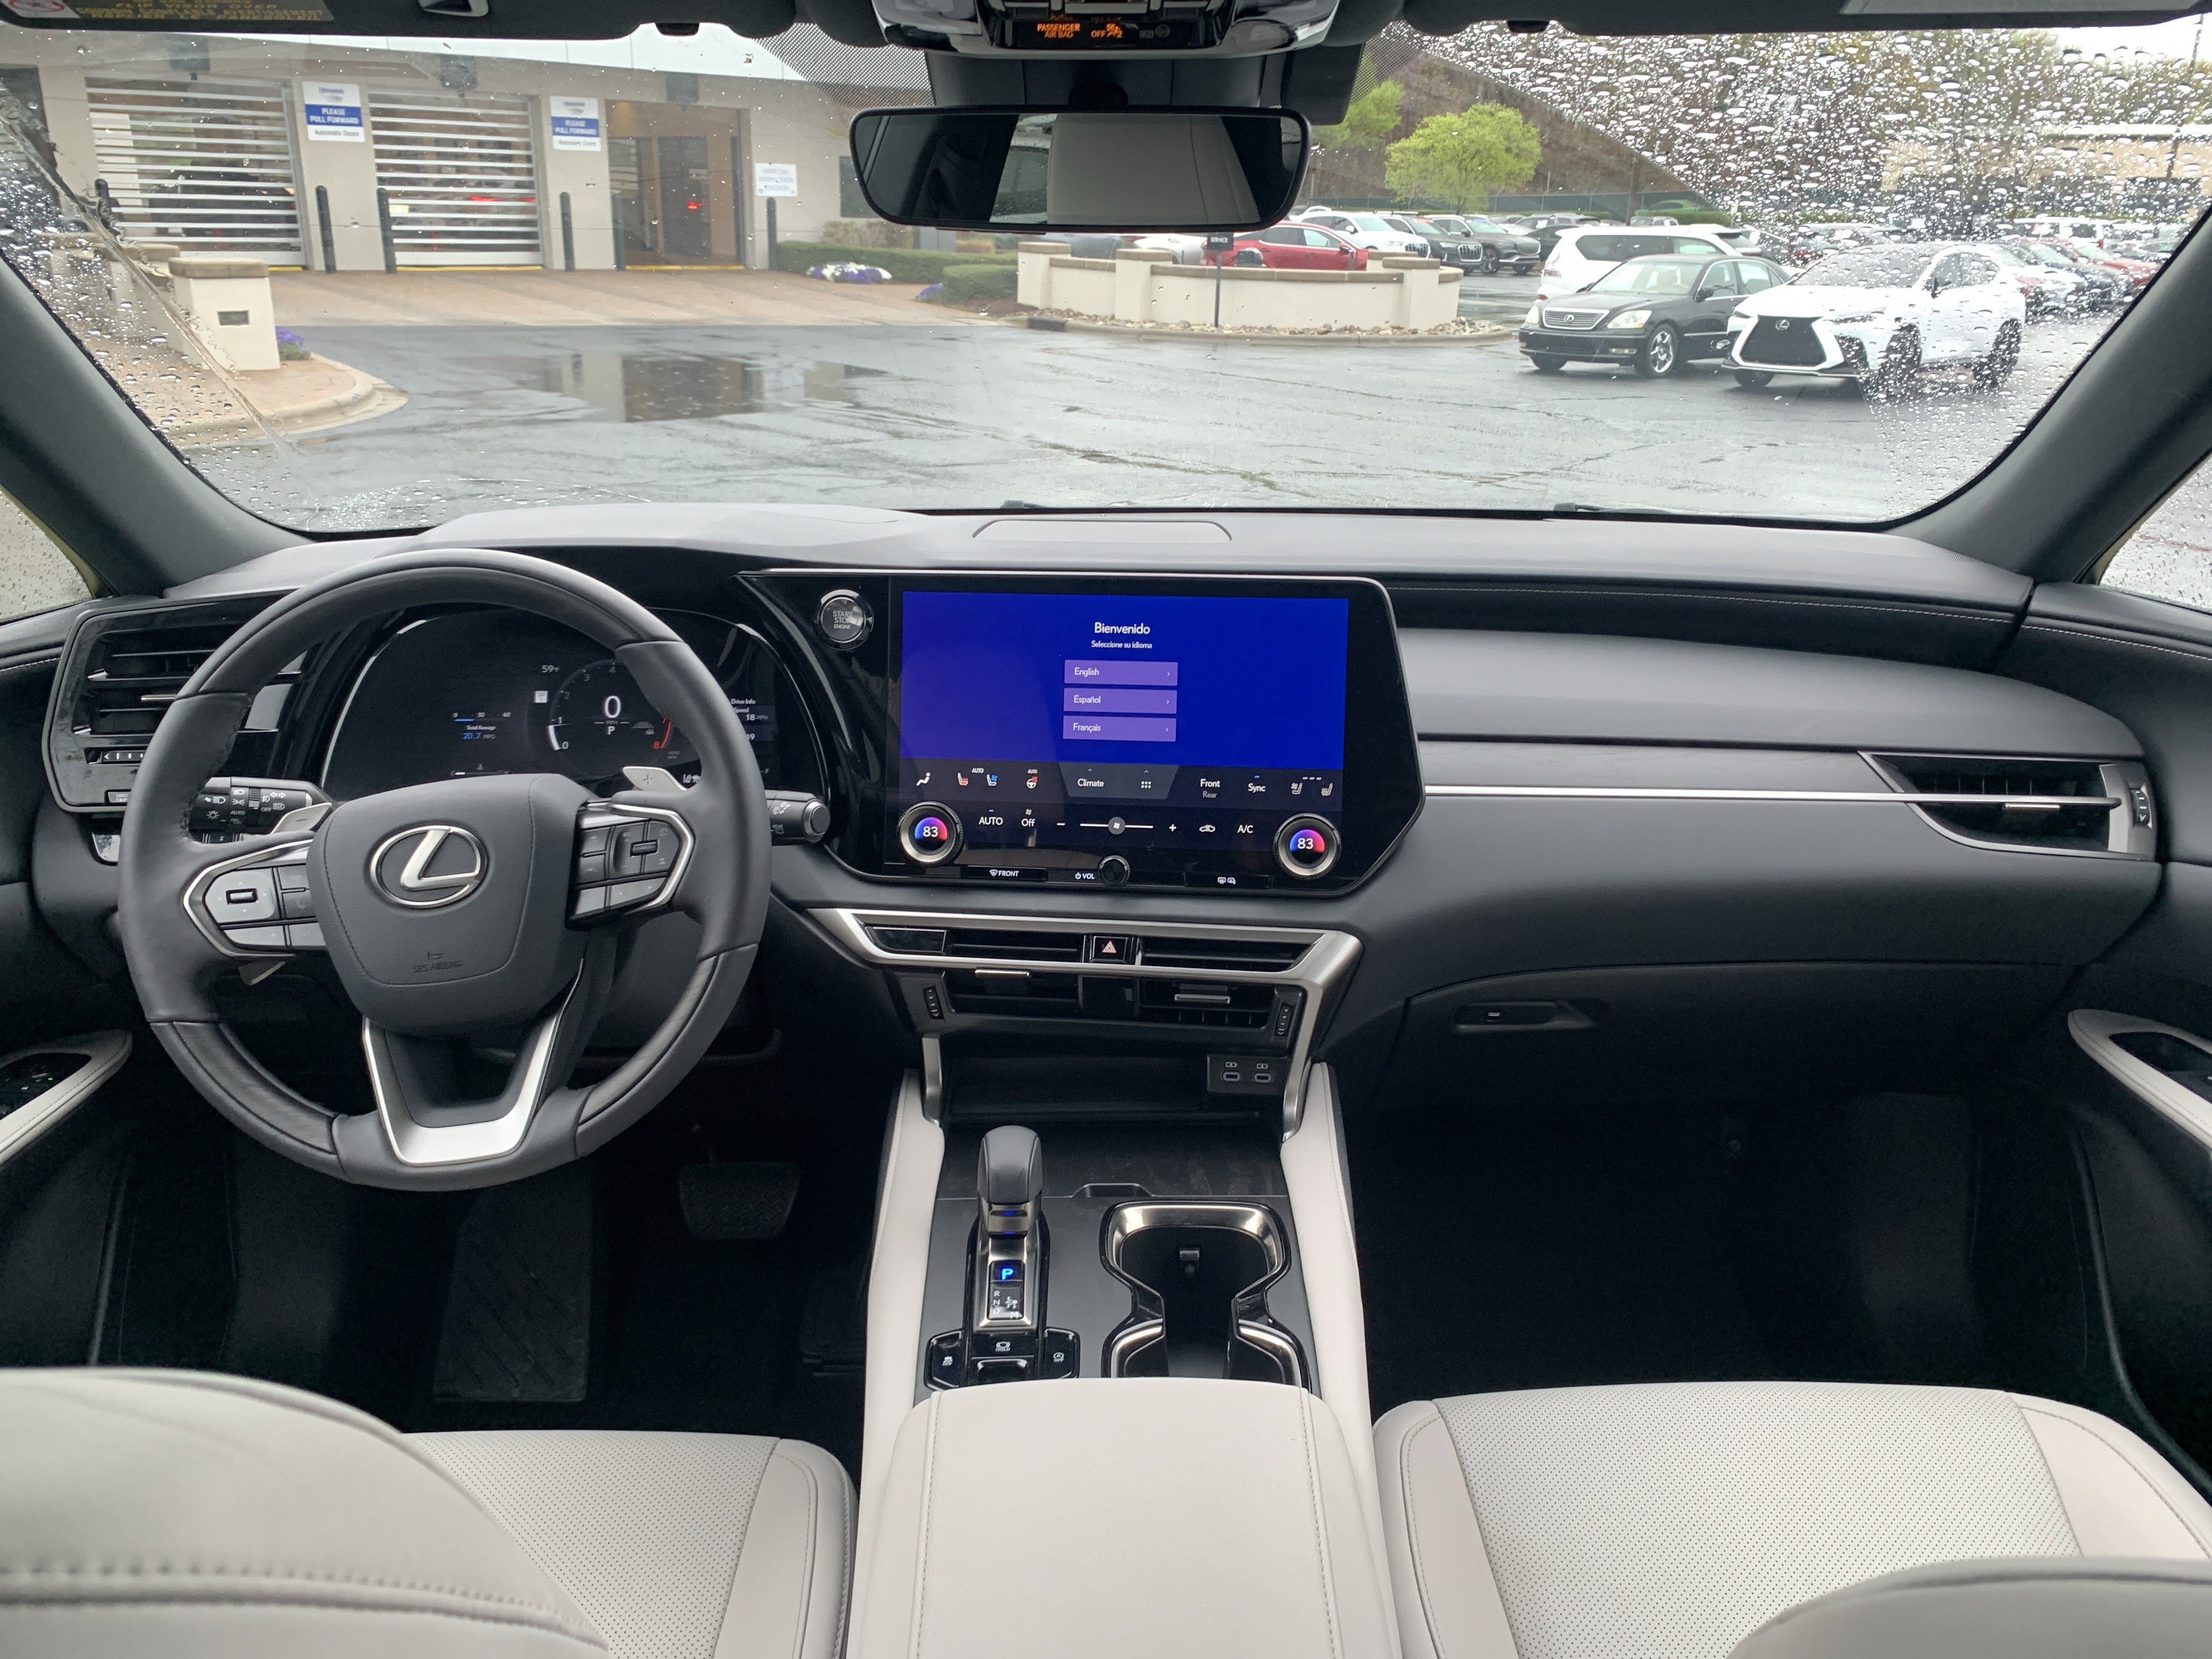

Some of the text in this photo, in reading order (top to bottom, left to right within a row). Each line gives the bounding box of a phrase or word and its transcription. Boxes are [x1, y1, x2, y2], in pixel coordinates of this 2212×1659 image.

[1037, 23, 1080, 32] PASSENGER
[1091, 30, 1106, 38] OFF
[309, 115, 359, 124] PULL FORWARD
[1094, 622, 1150, 634] Bienvenido
[1091, 640, 1123, 648] Seleccione
[1132, 641, 1153, 649] idioma
[1074, 667, 1099, 677] English
[1073, 694, 1102, 705] Español
[605, 695, 621, 719] 0
[608, 726, 616, 735] P
[1073, 723, 1101, 733] Français
[562, 741, 569, 749] 0
[653, 741, 660, 749] 8
[1077, 778, 1104, 788] Climate
[1200, 778, 1221, 788] Front
[1248, 783, 1266, 793] Sync
[1202, 791, 1217, 799] Rear
[979, 816, 1003, 826] AUTO
[1021, 818, 1036, 827] Off
[922, 826, 939, 838] 83
[1237, 825, 1254, 834] A/C
[1297, 838, 1314, 850] 83
[431, 961, 462, 971] AIRBAG
[1002, 1268, 1014, 1280] P
